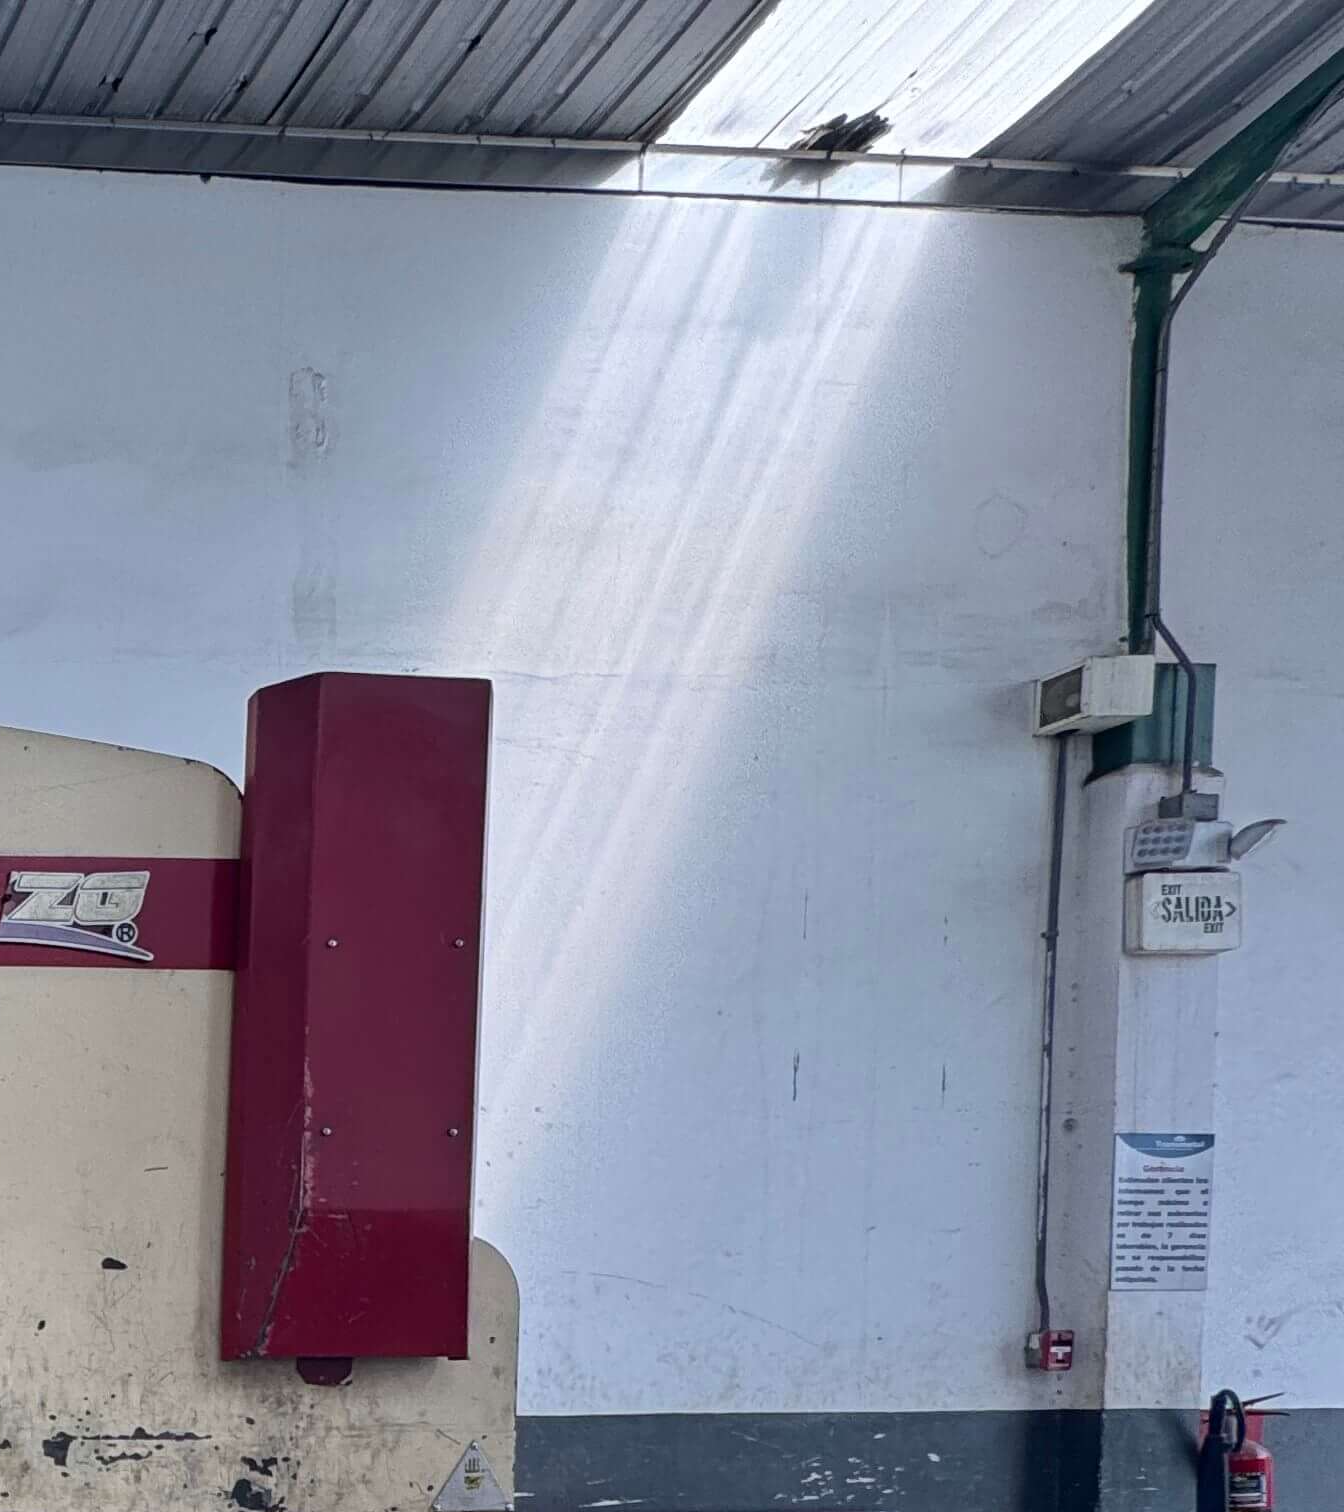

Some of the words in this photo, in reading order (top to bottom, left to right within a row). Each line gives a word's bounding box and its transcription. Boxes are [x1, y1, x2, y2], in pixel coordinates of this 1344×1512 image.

[1162, 884, 1182, 896] EXIT
[1162, 896, 1224, 923] SALIDA
[1203, 923, 1223, 934] EXIT
